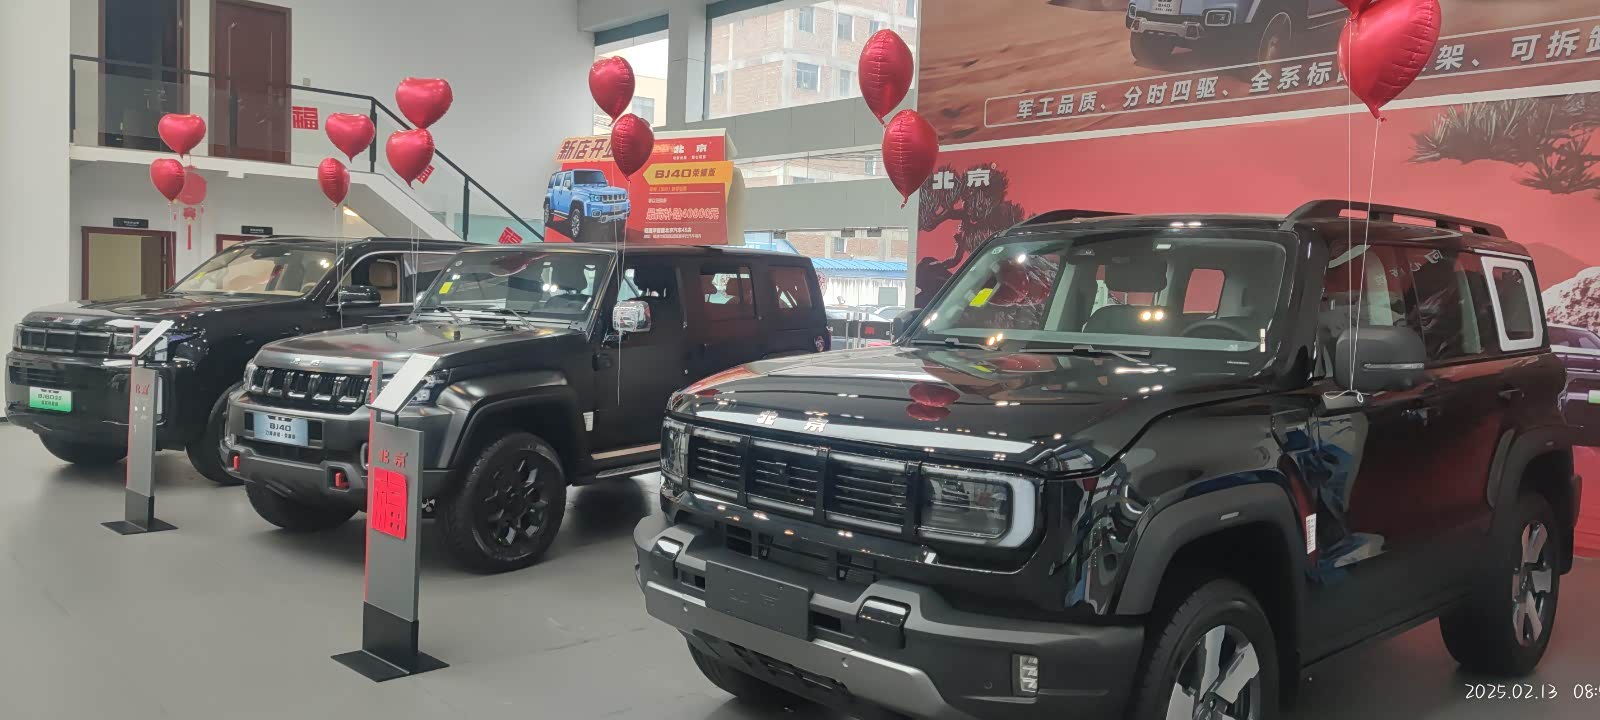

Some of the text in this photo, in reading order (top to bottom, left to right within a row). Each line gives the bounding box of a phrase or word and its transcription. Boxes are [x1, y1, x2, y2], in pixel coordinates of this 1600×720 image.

[292, 106, 318, 130] 福
[673, 143, 707, 154] 北京
[932, 168, 991, 190] 北京
[645, 207, 720, 221] 最高补贴40000元
[269, 422, 292, 432] BJ40
[756, 410, 829, 432] 北京
[378, 449, 408, 468] 北京
[371, 466, 408, 540] 福
